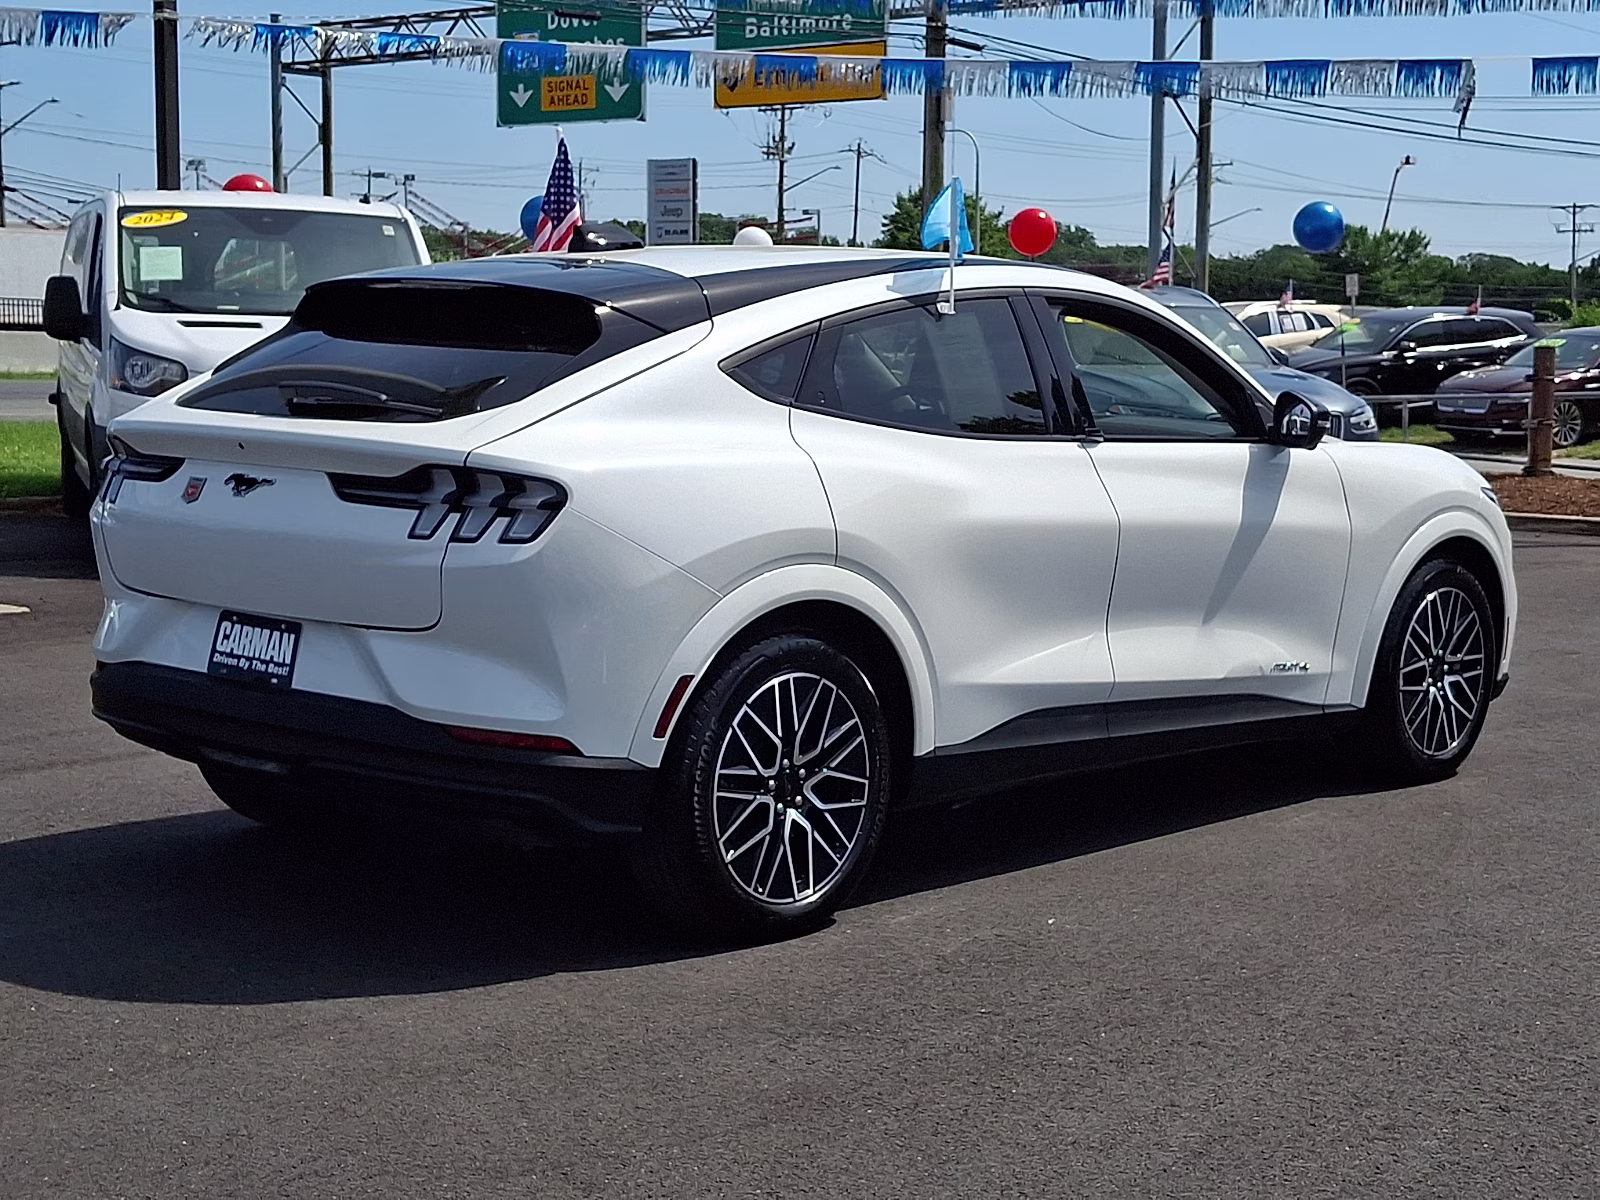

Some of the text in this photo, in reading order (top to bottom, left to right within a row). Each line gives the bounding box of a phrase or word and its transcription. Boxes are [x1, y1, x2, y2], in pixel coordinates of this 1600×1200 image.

[745, 14, 852, 38] Baltimore
[547, 79, 589, 93] SIGNAL
[549, 93, 588, 107] AHEAD
[216, 621, 295, 664] CARMAN
[213, 653, 290, 676] Driven By The Best!
